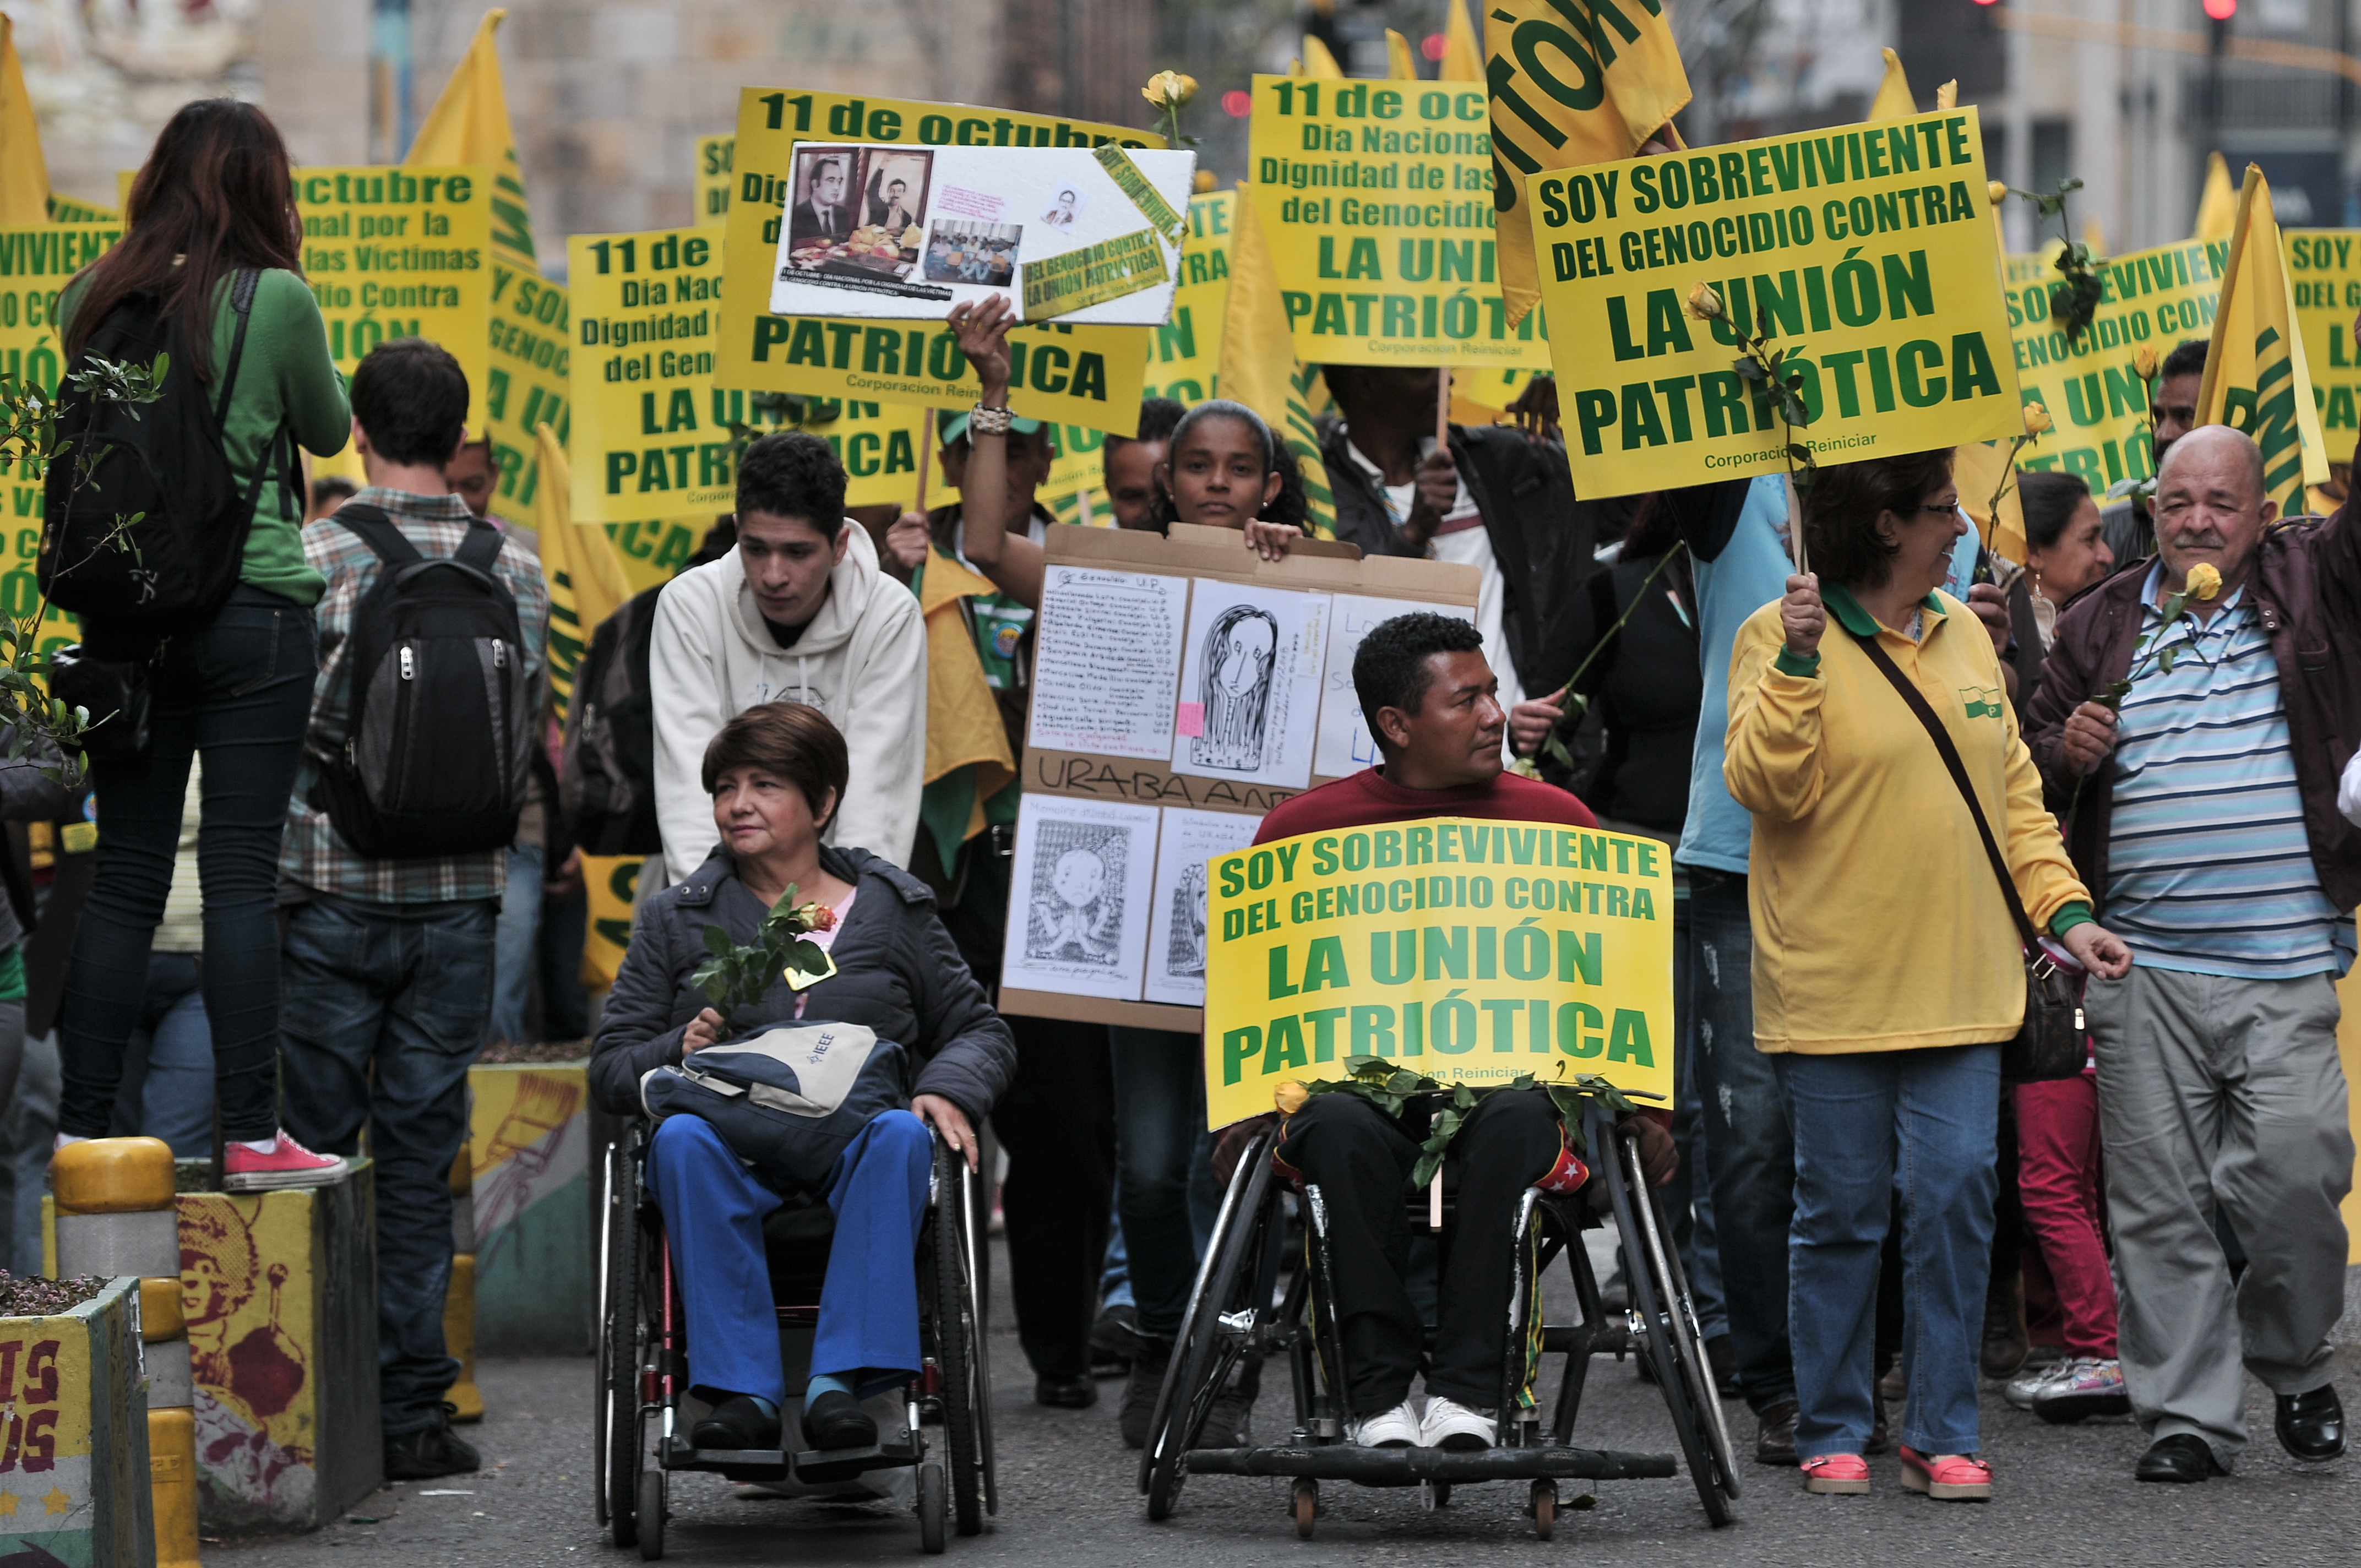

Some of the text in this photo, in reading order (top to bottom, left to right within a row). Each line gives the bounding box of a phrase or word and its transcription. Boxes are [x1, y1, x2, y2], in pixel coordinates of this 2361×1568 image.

[759, 93, 813, 131] 11
[829, 100, 902, 140] de
[1272, 81, 1319, 116] 11
[1336, 84, 1402, 118] de
[1303, 124, 1352, 152] Dia
[1261, 158, 1398, 189] Dignidad
[1407, 163, 1444, 189] de
[1539, 116, 1971, 228] SOY SOBREVIVIENTE
[1114, 165, 1185, 242] SOBREVIVIEN
[1282, 197, 1330, 225] del
[359, 214, 409, 239] por
[424, 210, 450, 237] la
[1552, 181, 1976, 282] DEL GENOCIDIO CONTRA
[306, 245, 480, 271] las Víctimas
[587, 235, 709, 274] 11 de
[1318, 236, 1382, 280] LA
[2292, 237, 2351, 270] SOY
[361, 284, 459, 308] Contra
[1606, 246, 1935, 362] LA UNIÓN
[2295, 281, 2337, 307] DEL
[581, 309, 708, 348] Dignidad
[605, 355, 651, 382] del
[752, 315, 1107, 402] PATRIÓICA
[641, 389, 698, 434] LA
[1806, 434, 1877, 455] Reiniciar
[1988, 706, 1996, 716] P
[1039, 756, 1194, 806] URABA
[1220, 825, 1660, 899] SOY SOBREVIVIENTE
[1223, 876, 1655, 942] DEL GENOCIDIO CONTRA
[1269, 917, 1603, 1001] LA UNIÓN
[813, 1033, 835, 1055] IEEE
[1223, 988, 1655, 1086] PATRIÓTICA
[1452, 1064, 1527, 1080] Reiniciar
